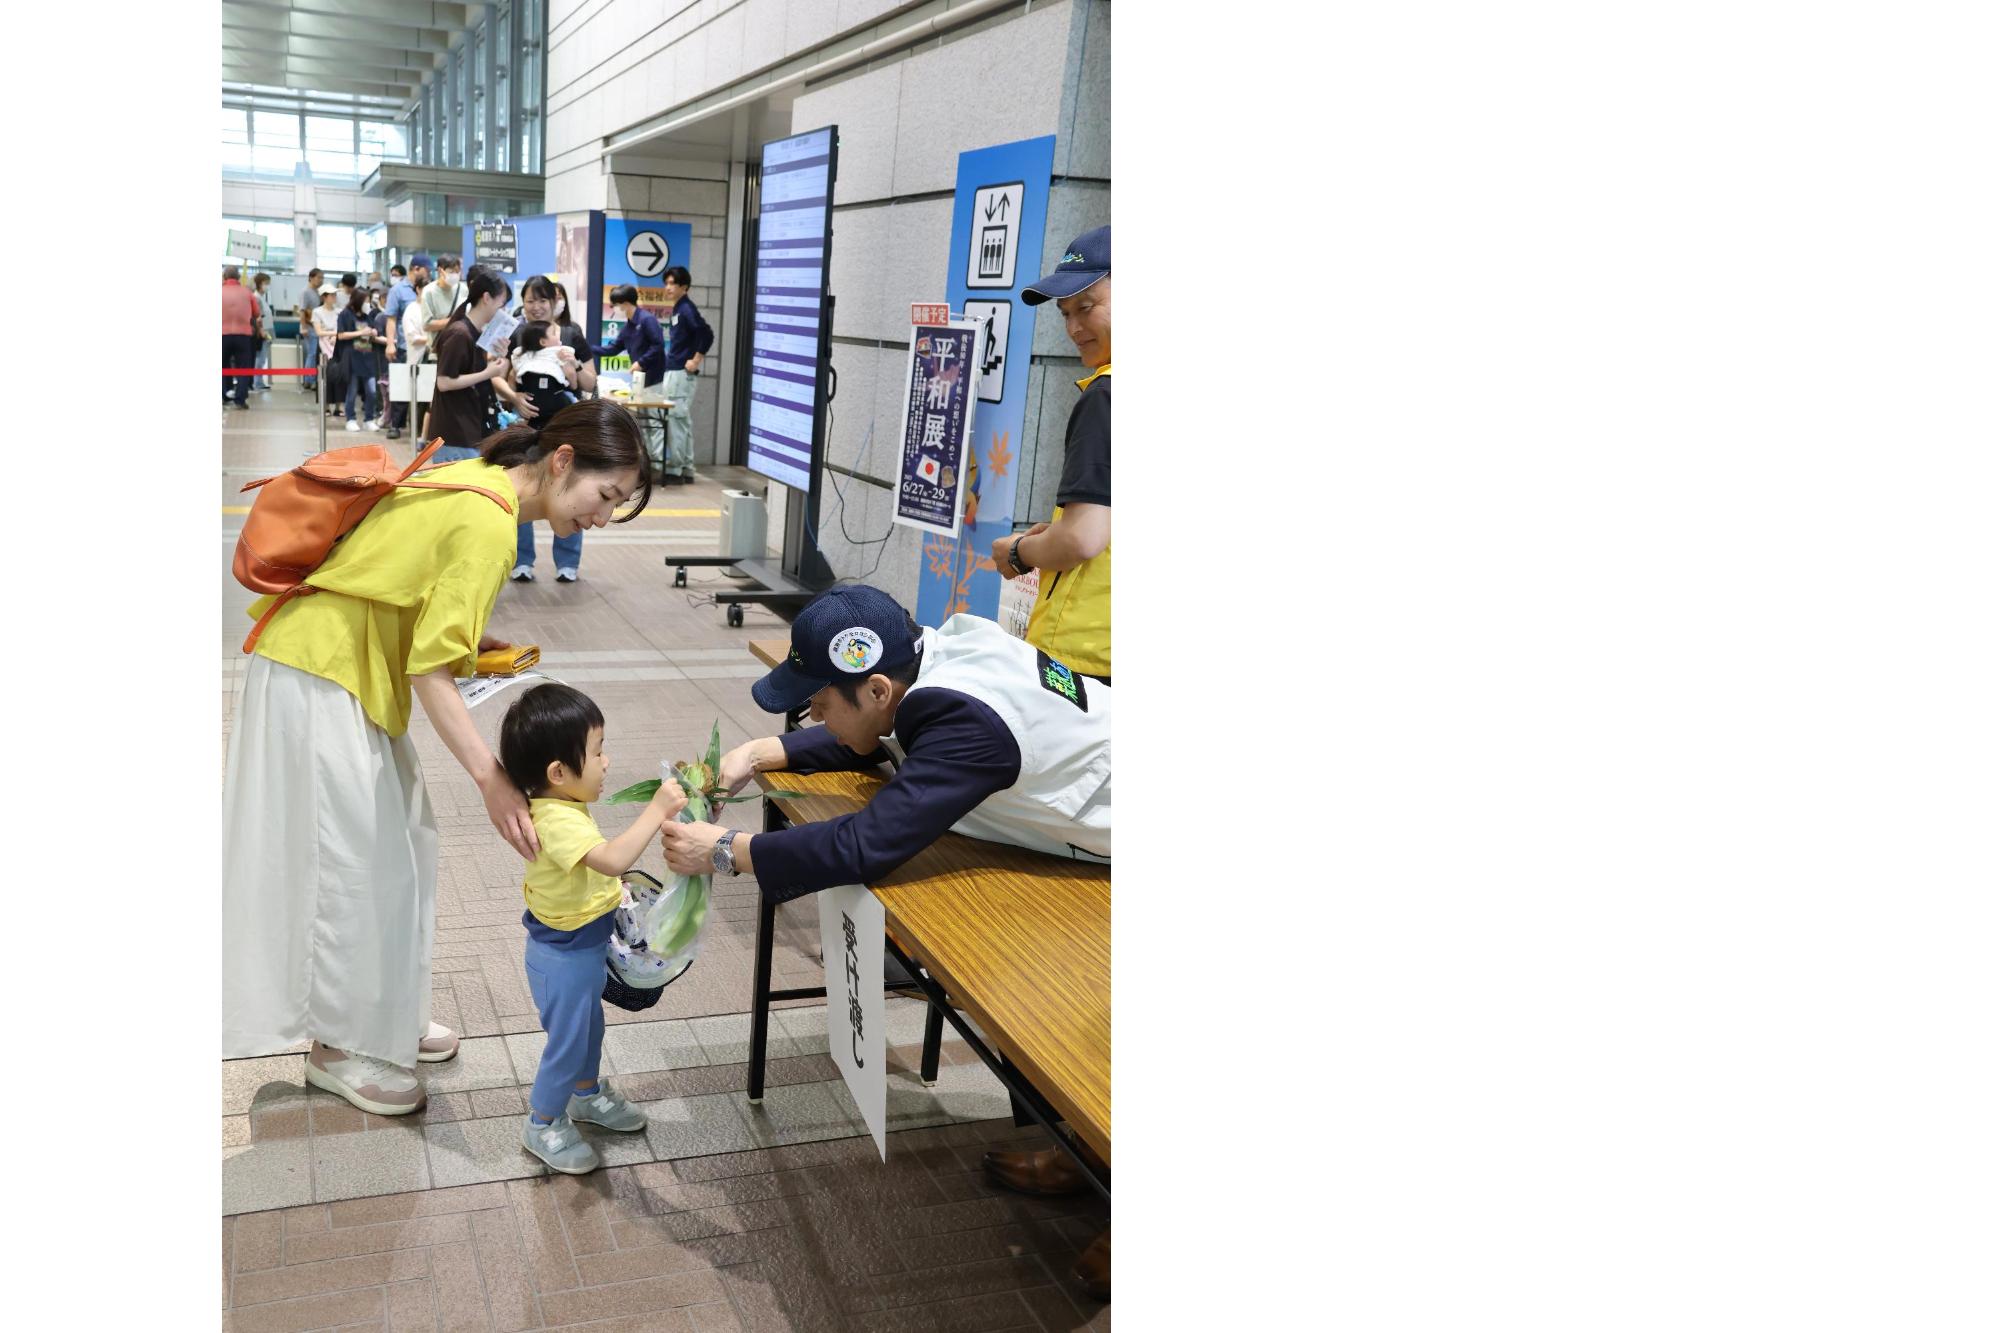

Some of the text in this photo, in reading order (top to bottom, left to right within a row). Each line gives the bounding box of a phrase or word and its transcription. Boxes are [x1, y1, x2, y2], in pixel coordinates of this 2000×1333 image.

[913, 306, 947, 323] 開催予定
[921, 337, 955, 451] 平和展
[841, 909, 865, 1069] 受け渡し
